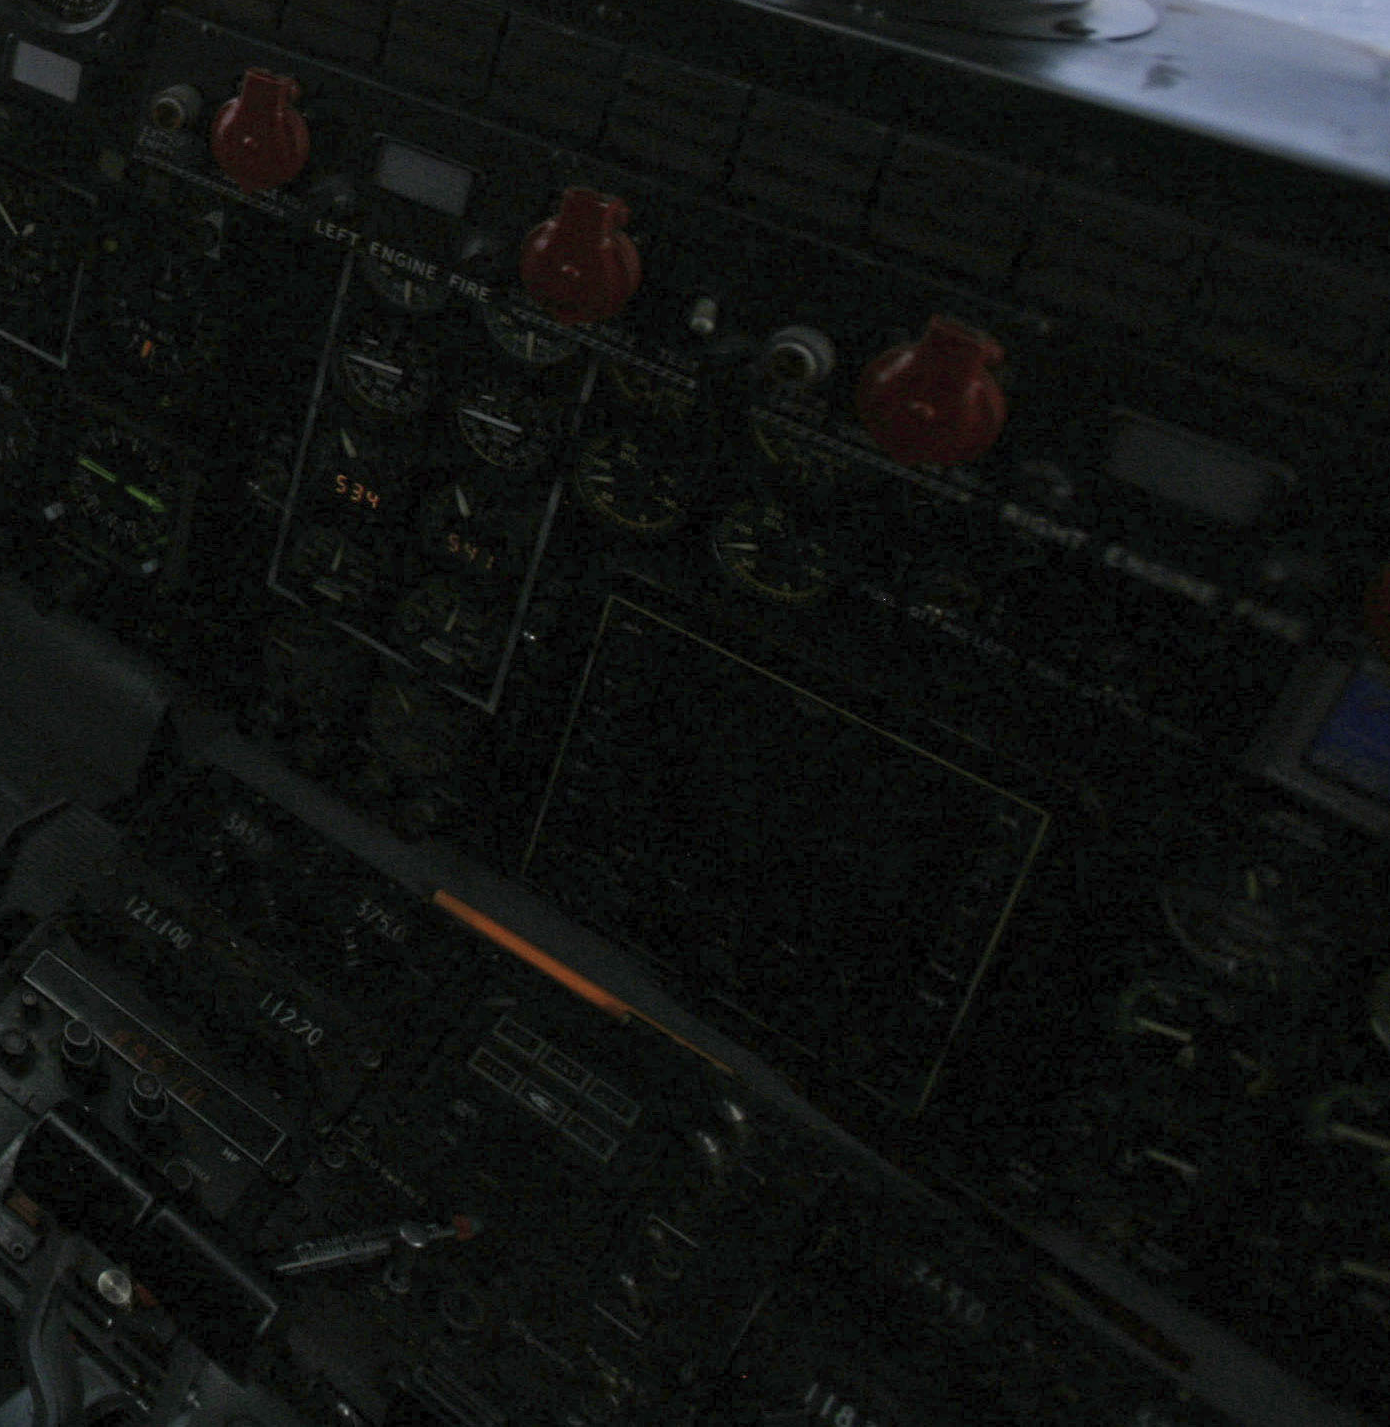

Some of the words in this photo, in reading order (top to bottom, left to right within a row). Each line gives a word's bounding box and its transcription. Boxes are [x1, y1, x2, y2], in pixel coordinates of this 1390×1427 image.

[314, 219, 361, 247] LEFT
[369, 240, 439, 281] ENGINE
[449, 273, 492, 304] FIRE
[334, 473, 381, 510] 534
